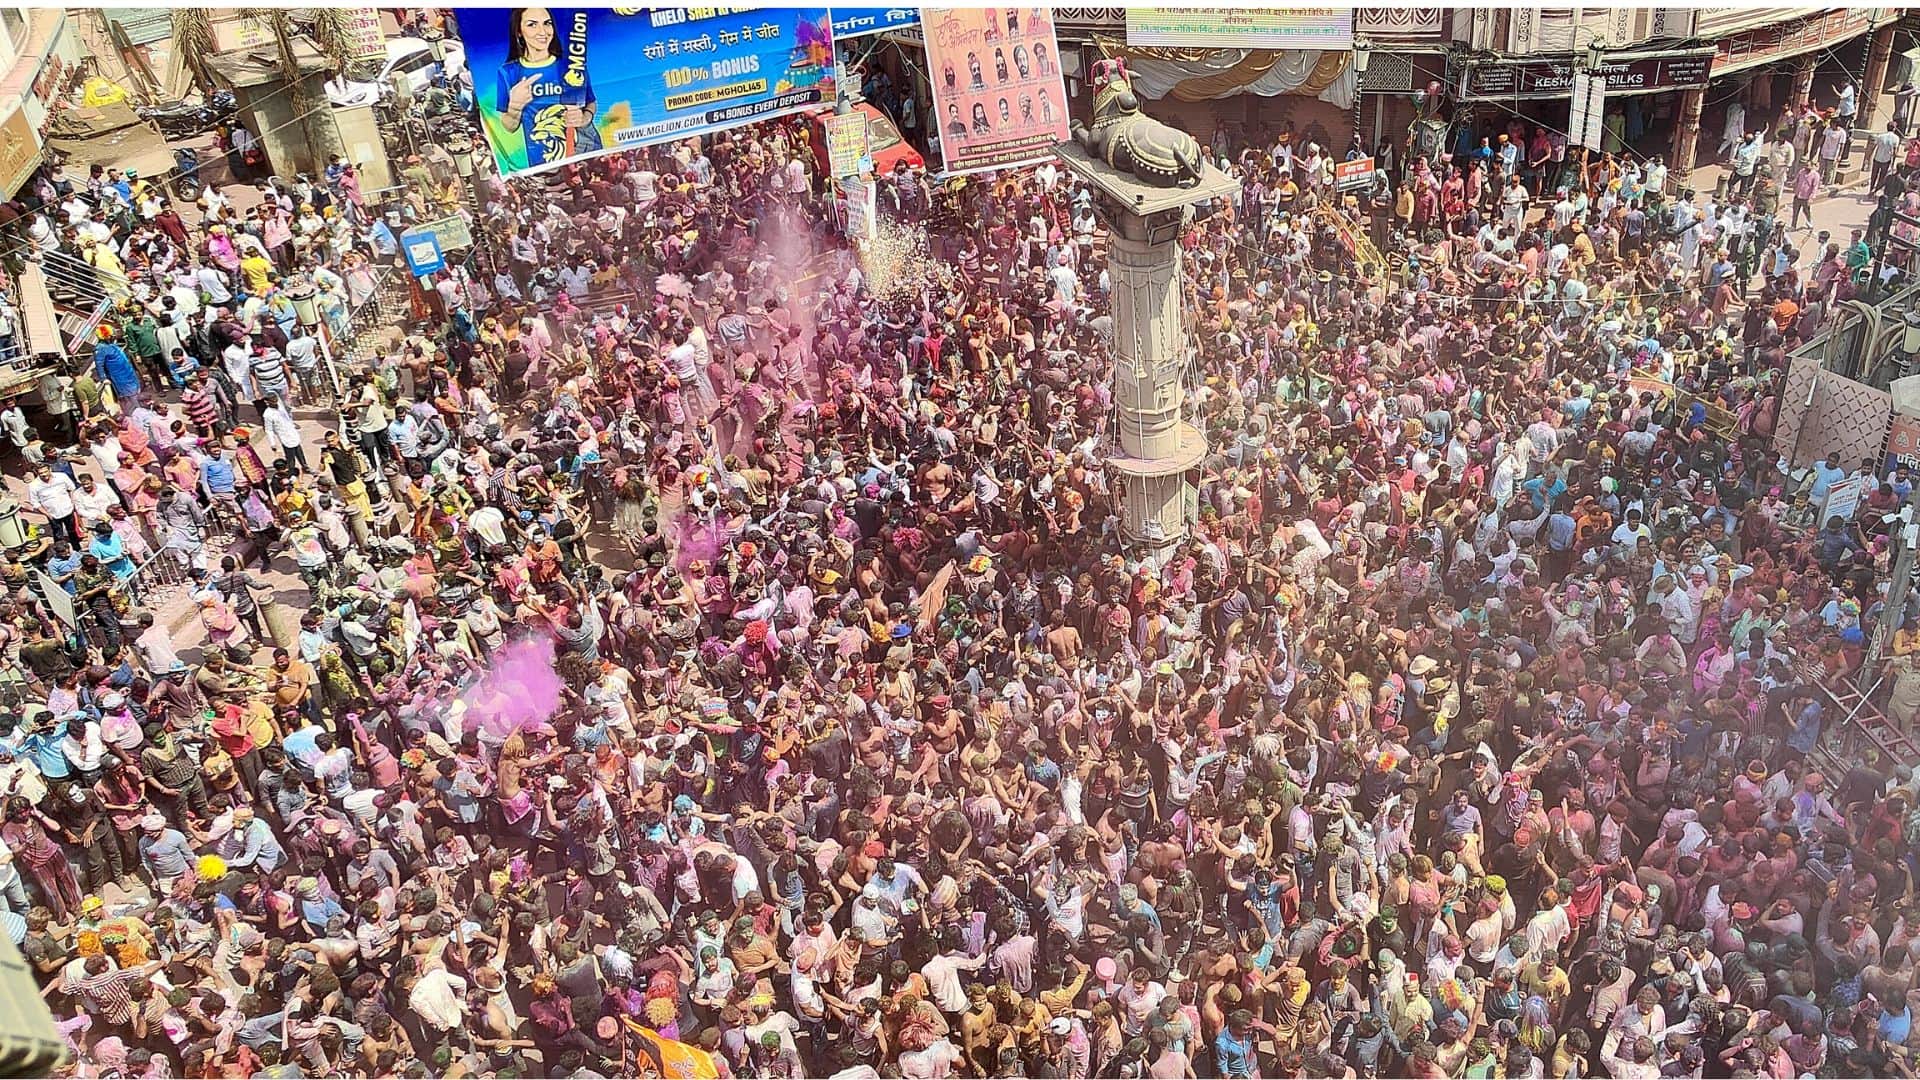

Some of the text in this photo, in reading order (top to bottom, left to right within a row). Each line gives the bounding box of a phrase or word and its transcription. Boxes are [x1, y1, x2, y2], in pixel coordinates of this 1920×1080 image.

[650, 8, 686, 28] KHELO
[568, 12, 587, 71] MGlion
[643, 22, 780, 60] रंगों में मस्ती, गेम में जीत
[662, 54, 760, 89] 100% BONUS
[1608, 74, 1644, 85] SILKS
[529, 82, 562, 96] Glio
[668, 82, 762, 107] PROMO CODE: MGHOLI45
[617, 116, 704, 142] WWW.MGLION.COM
[726, 105, 754, 120] BONUS
[754, 98, 781, 113] EVERY
[780, 91, 812, 107] DEPOSIT
